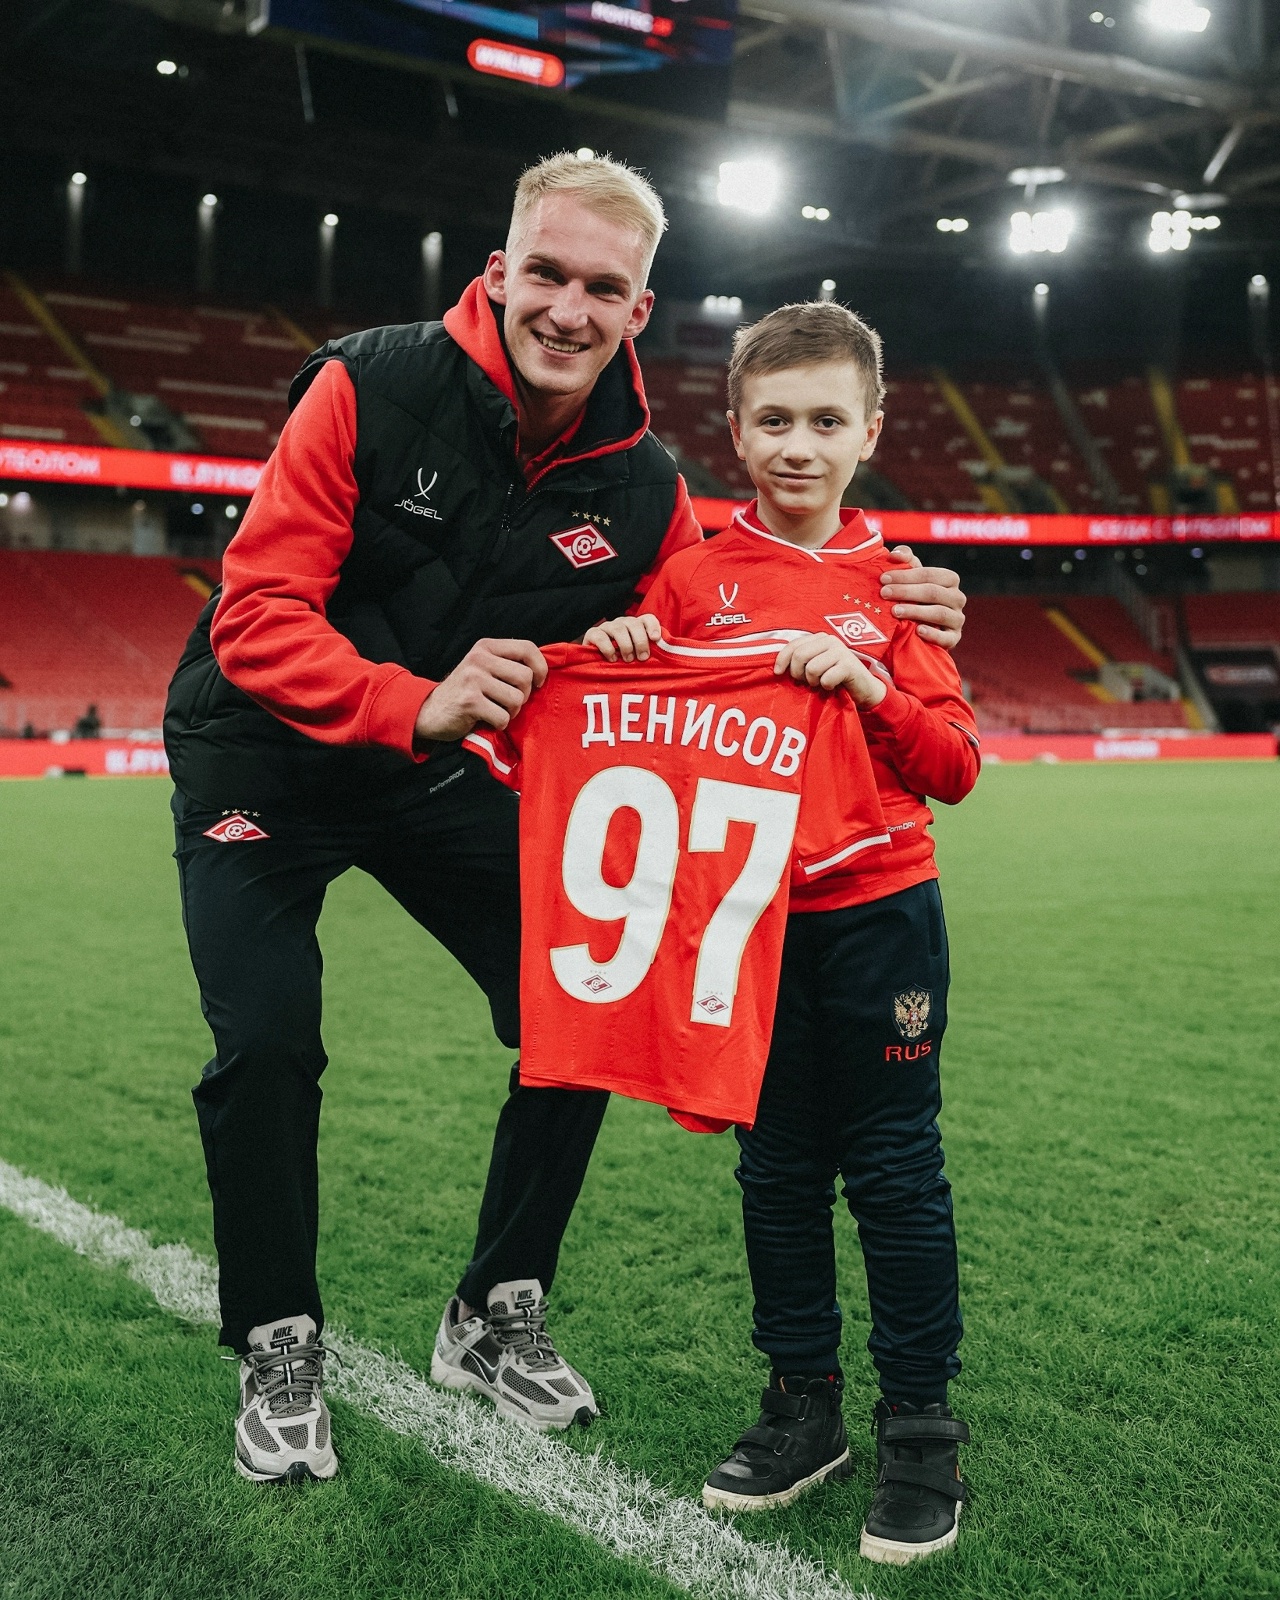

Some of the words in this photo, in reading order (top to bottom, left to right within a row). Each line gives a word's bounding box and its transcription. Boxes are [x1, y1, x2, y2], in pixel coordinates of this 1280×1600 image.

[394, 498, 443, 521] JÖGEL
[705, 613, 752, 627] JÖGEL
[581, 693, 807, 777] ДЕНИСОВ
[549, 765, 801, 1028] 97
[885, 1039, 932, 1062] RUS
[517, 1289, 533, 1301] NIKE
[272, 1325, 293, 1341] NIKE
